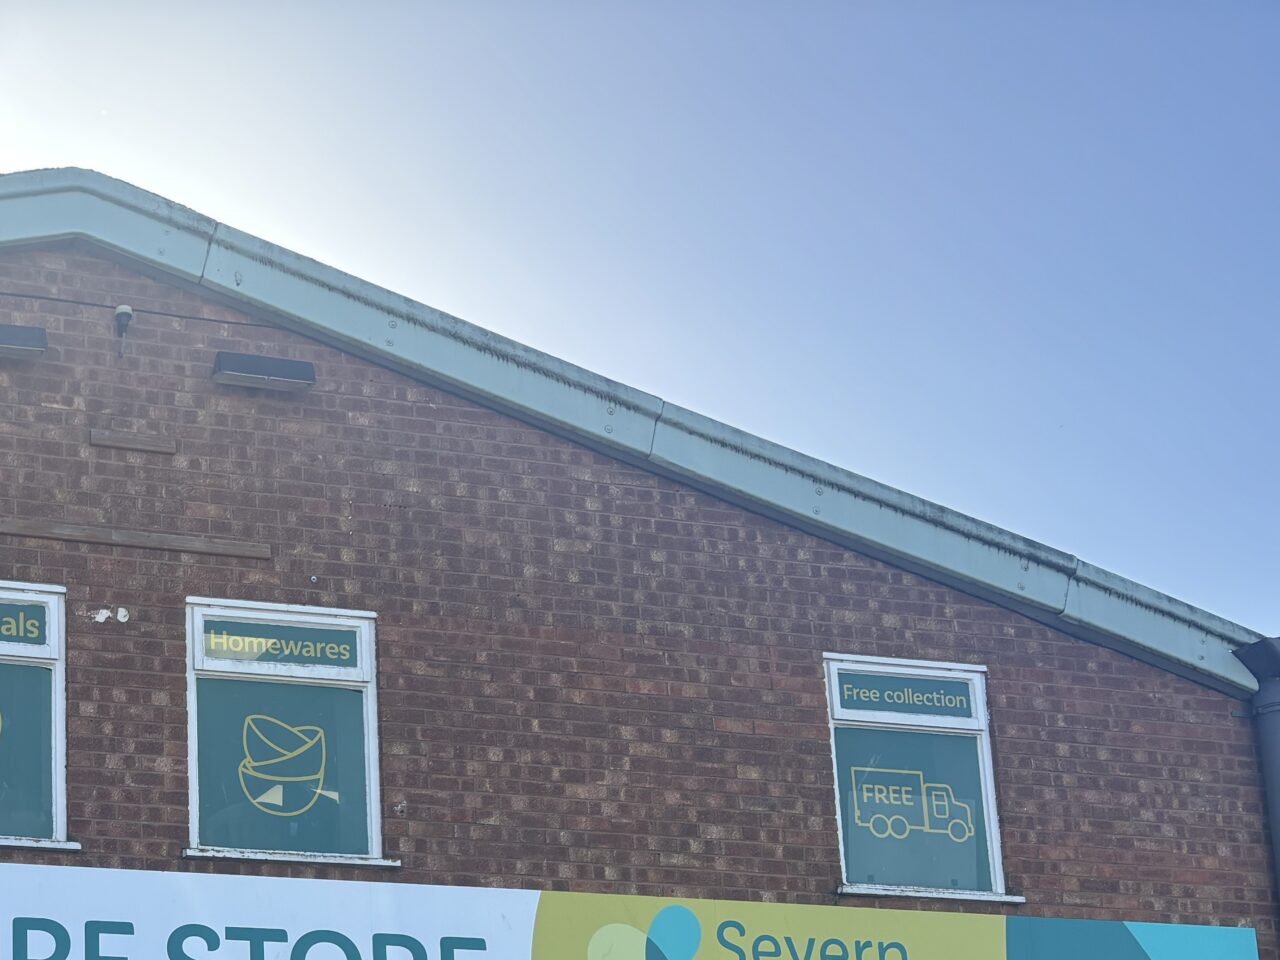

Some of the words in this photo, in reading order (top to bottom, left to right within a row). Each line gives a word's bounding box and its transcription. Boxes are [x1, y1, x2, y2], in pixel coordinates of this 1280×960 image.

[209, 629, 351, 661] Homewares
[843, 684, 880, 702] Free
[884, 688, 967, 709] collection
[862, 784, 914, 806] FREE
